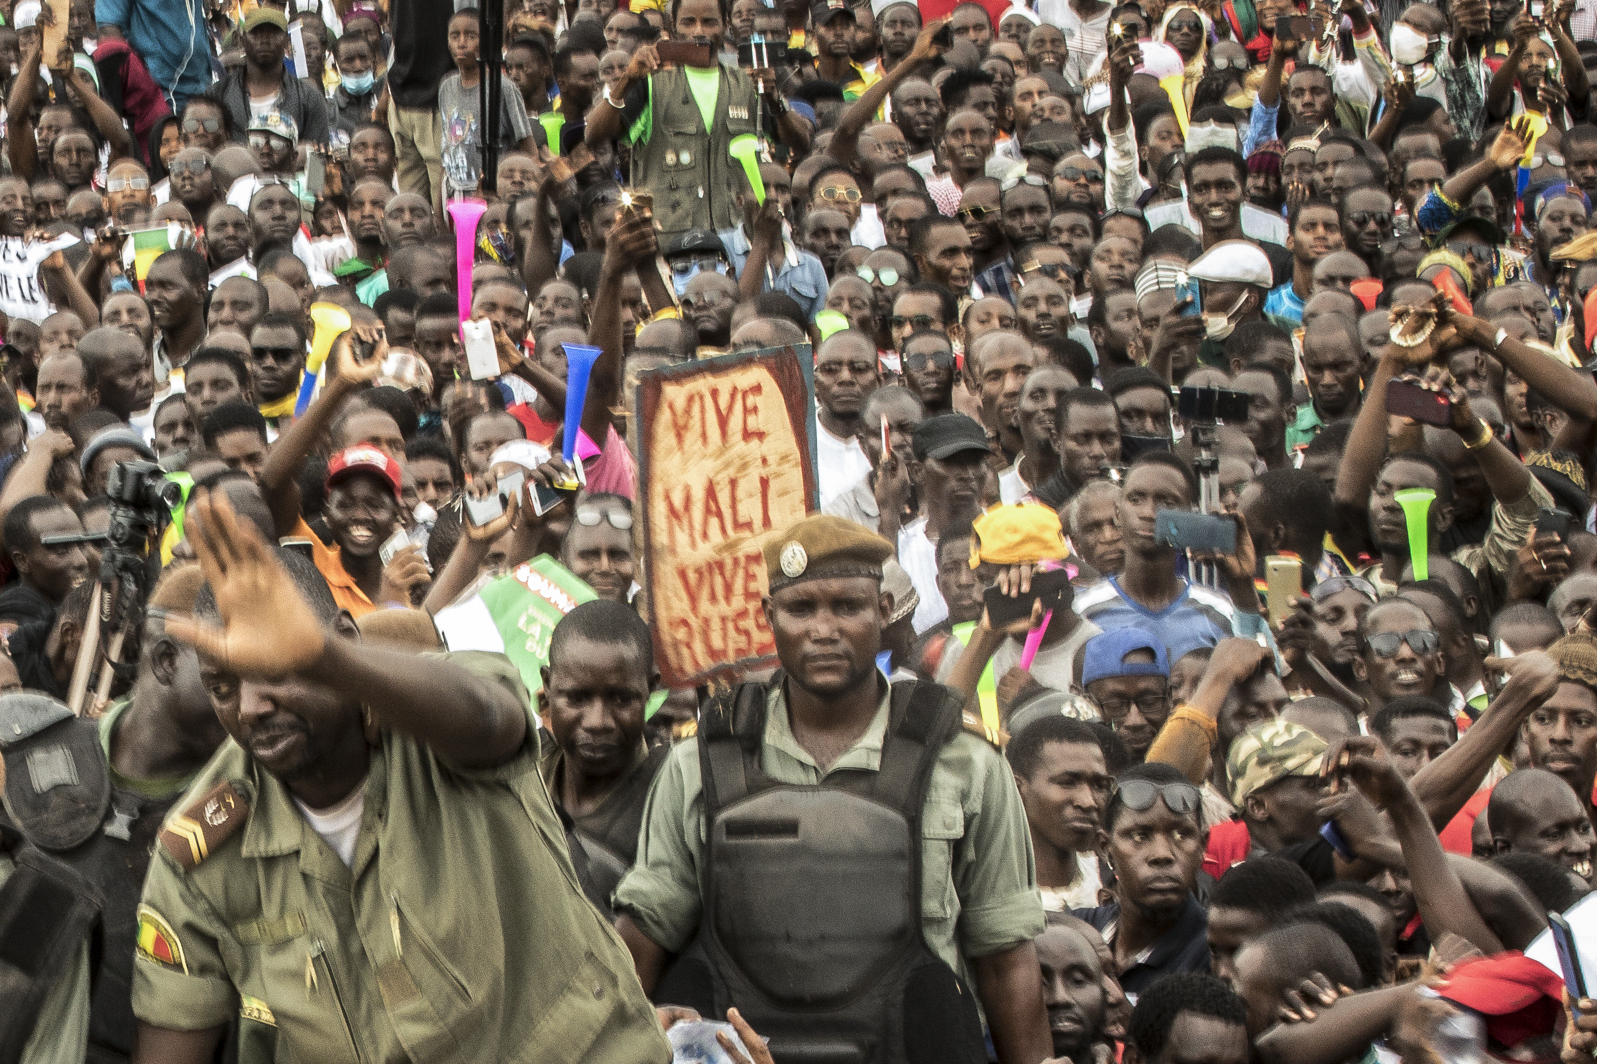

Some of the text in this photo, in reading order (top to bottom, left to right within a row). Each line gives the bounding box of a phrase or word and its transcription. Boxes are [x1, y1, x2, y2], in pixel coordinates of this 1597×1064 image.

[666, 382, 766, 452] VIVE
[664, 455, 772, 556] MALI
[677, 551, 763, 618] VIVE
[517, 611, 542, 641] LA
